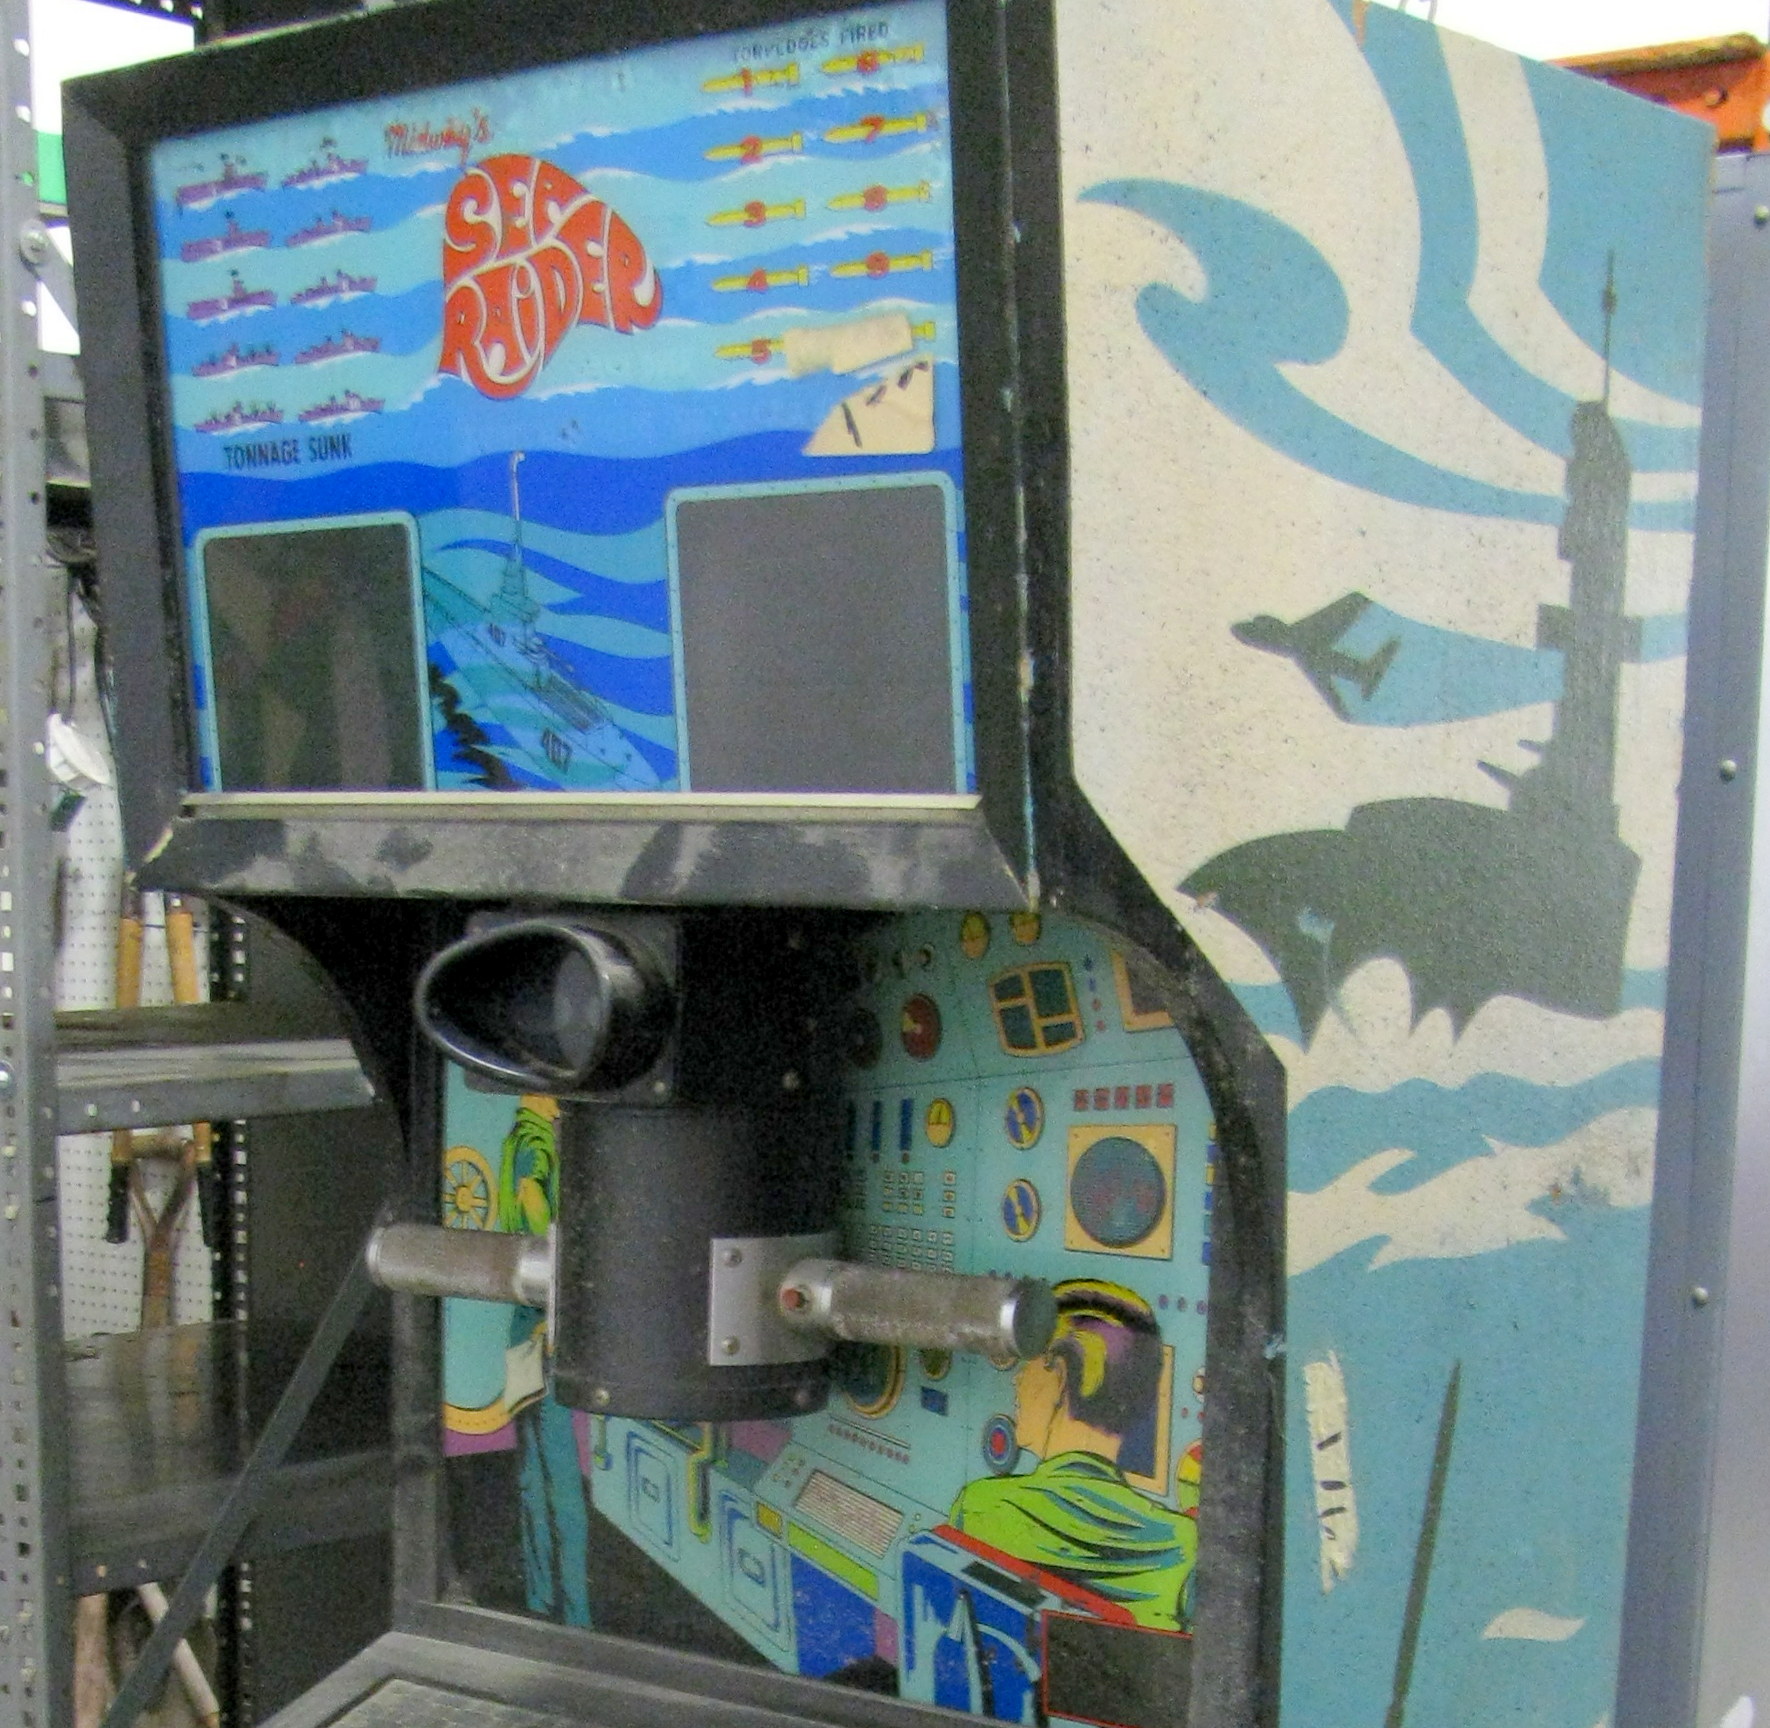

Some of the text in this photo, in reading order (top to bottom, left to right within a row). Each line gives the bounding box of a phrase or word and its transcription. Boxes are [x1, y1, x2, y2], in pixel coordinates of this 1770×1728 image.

[741, 67, 752, 97] 1
[385, 108, 491, 165] Midway's
[860, 115, 884, 143] 7
[741, 136, 762, 164] 2
[443, 153, 590, 282] SEA
[745, 201, 766, 228] 3
[747, 268, 768, 292] 4
[752, 339, 771, 364] 5
[223, 432, 352, 470] TONNAGE SUNK
